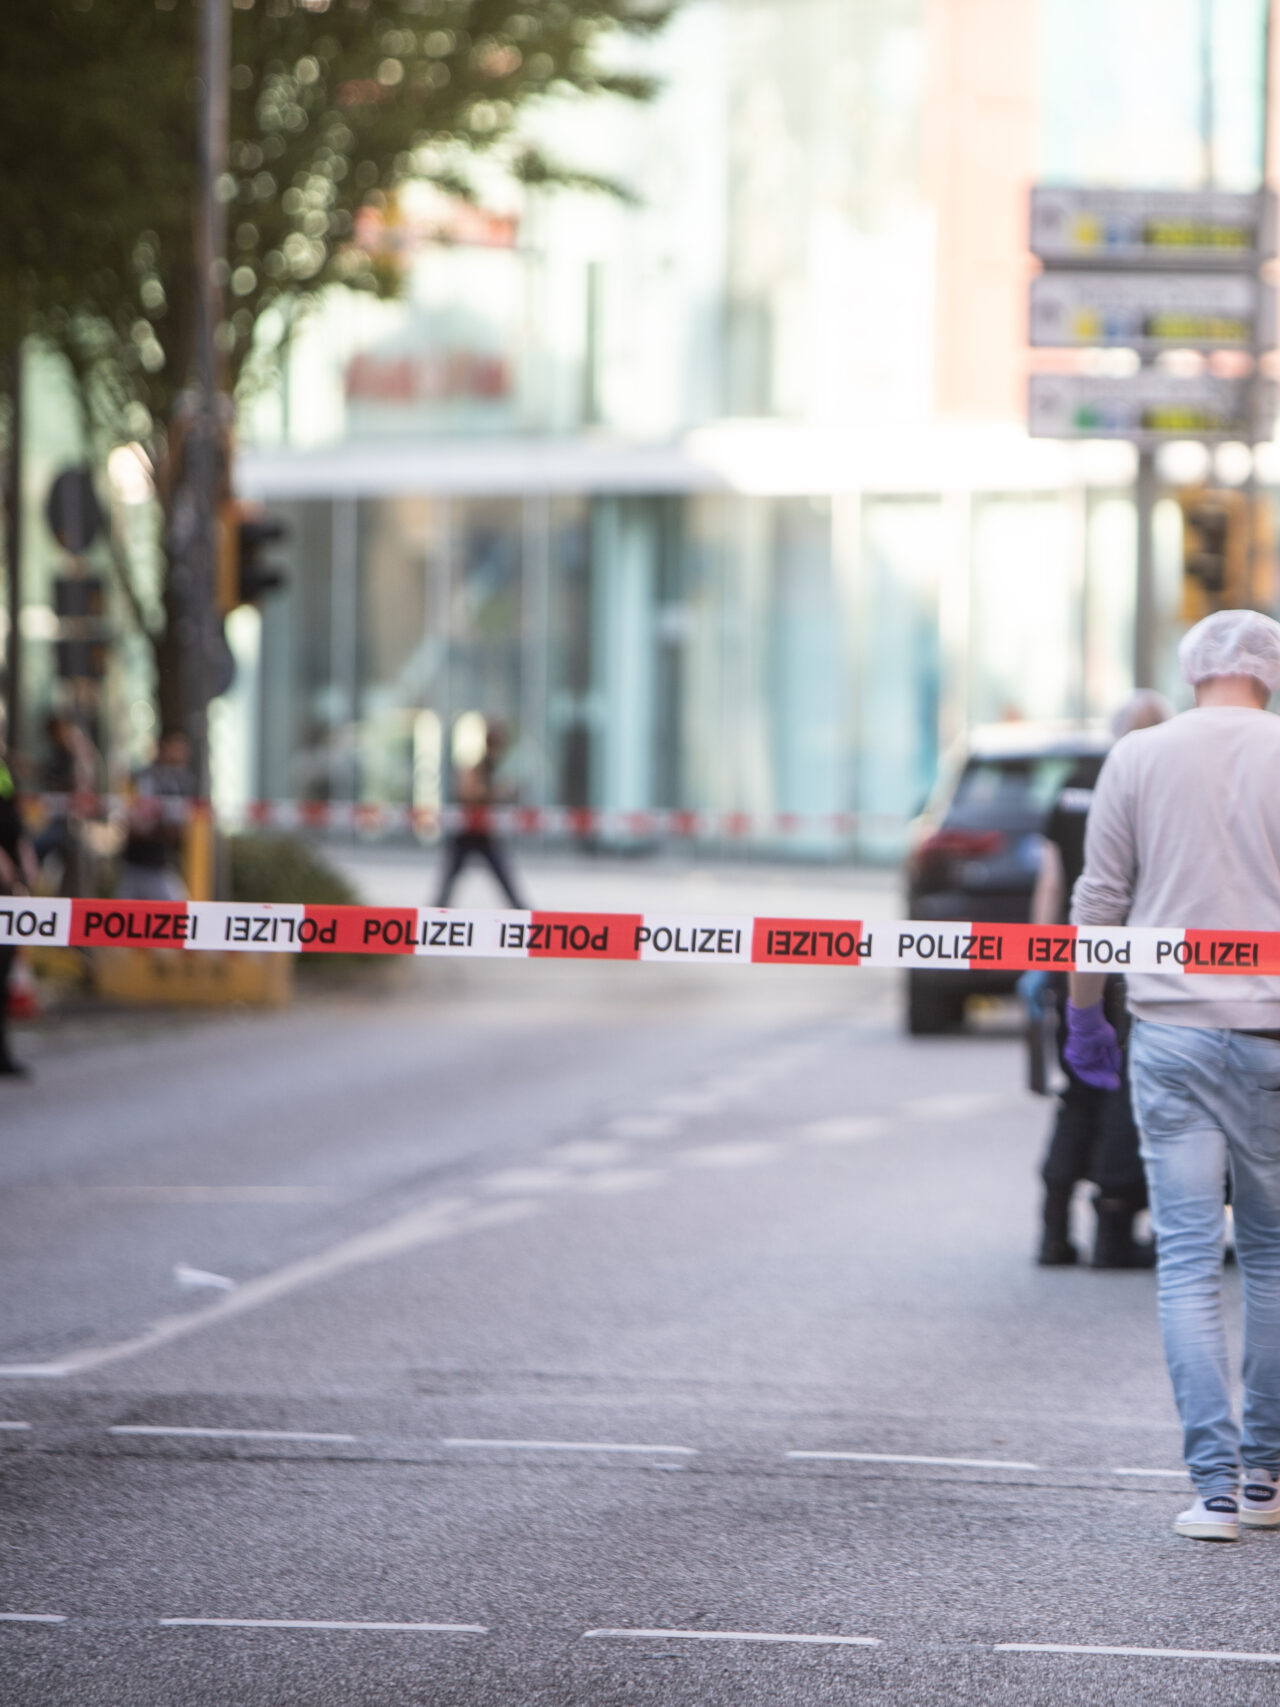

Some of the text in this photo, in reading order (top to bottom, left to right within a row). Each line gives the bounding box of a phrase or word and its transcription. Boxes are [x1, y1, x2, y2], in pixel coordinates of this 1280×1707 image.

[83, 911, 198, 940] POLIZEI
[224, 916, 337, 944] POLIZEI
[362, 919, 474, 947] POLIZEI
[499, 923, 609, 951] POLIZEI
[633, 926, 742, 954] POLIZEI
[766, 930, 873, 957] POLIZEI
[898, 933, 1003, 960] POLIZEI
[1027, 937, 1131, 964] POLIZEI
[1156, 940, 1259, 967] POLIZEI
